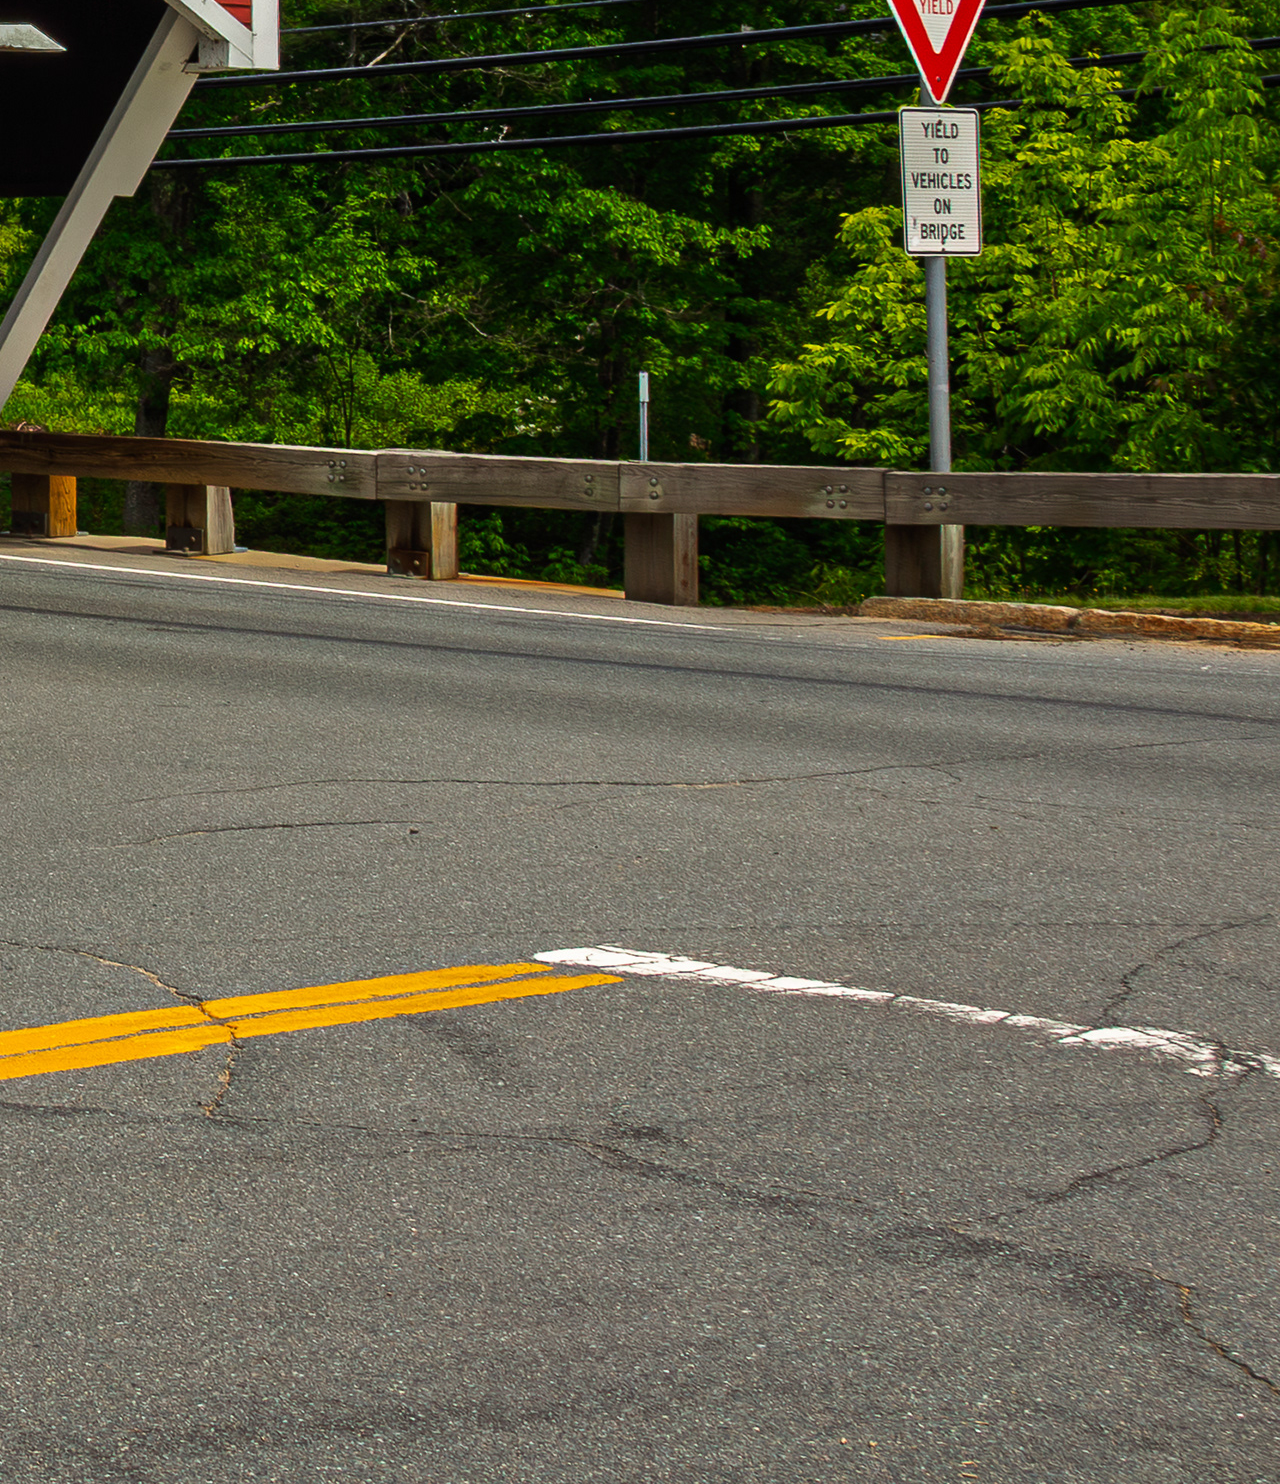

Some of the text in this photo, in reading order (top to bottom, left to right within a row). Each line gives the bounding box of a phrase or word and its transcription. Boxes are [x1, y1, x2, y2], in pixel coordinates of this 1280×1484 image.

[921, 122, 959, 139] YIELD
[932, 148, 948, 164] TO
[911, 172, 972, 190] VEHICLES
[934, 198, 951, 215] ON
[920, 224, 965, 240] BRIDGE
